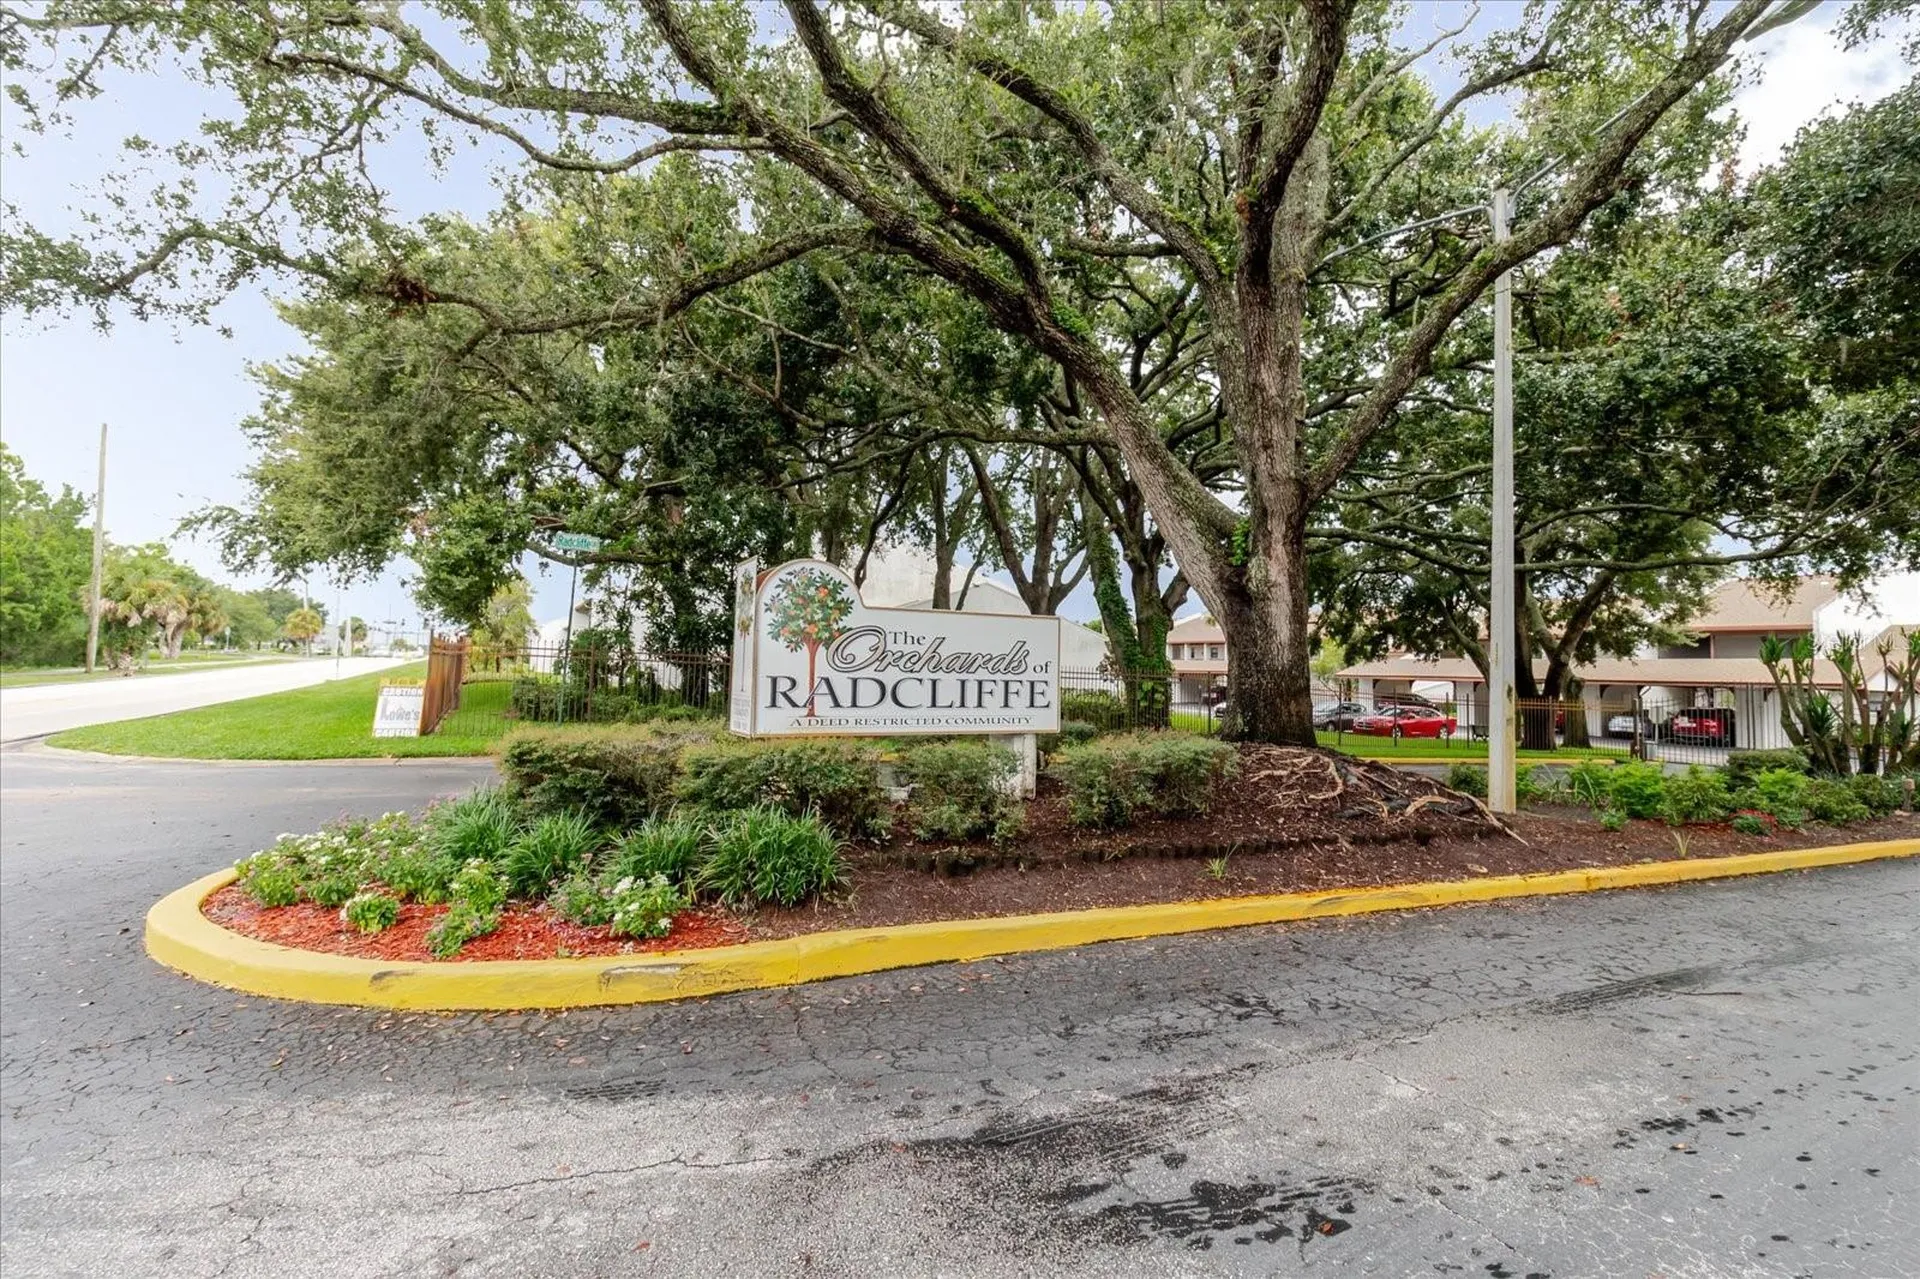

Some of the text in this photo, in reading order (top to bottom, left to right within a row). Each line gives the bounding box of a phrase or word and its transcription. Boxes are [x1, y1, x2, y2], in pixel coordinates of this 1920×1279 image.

[826, 624, 1052, 676] Orchards of
[888, 630, 926, 646] The
[764, 675, 1051, 709] RADCLIFFE
[790, 716, 1033, 727] A DEED RESTRICTED COMMUNITY
